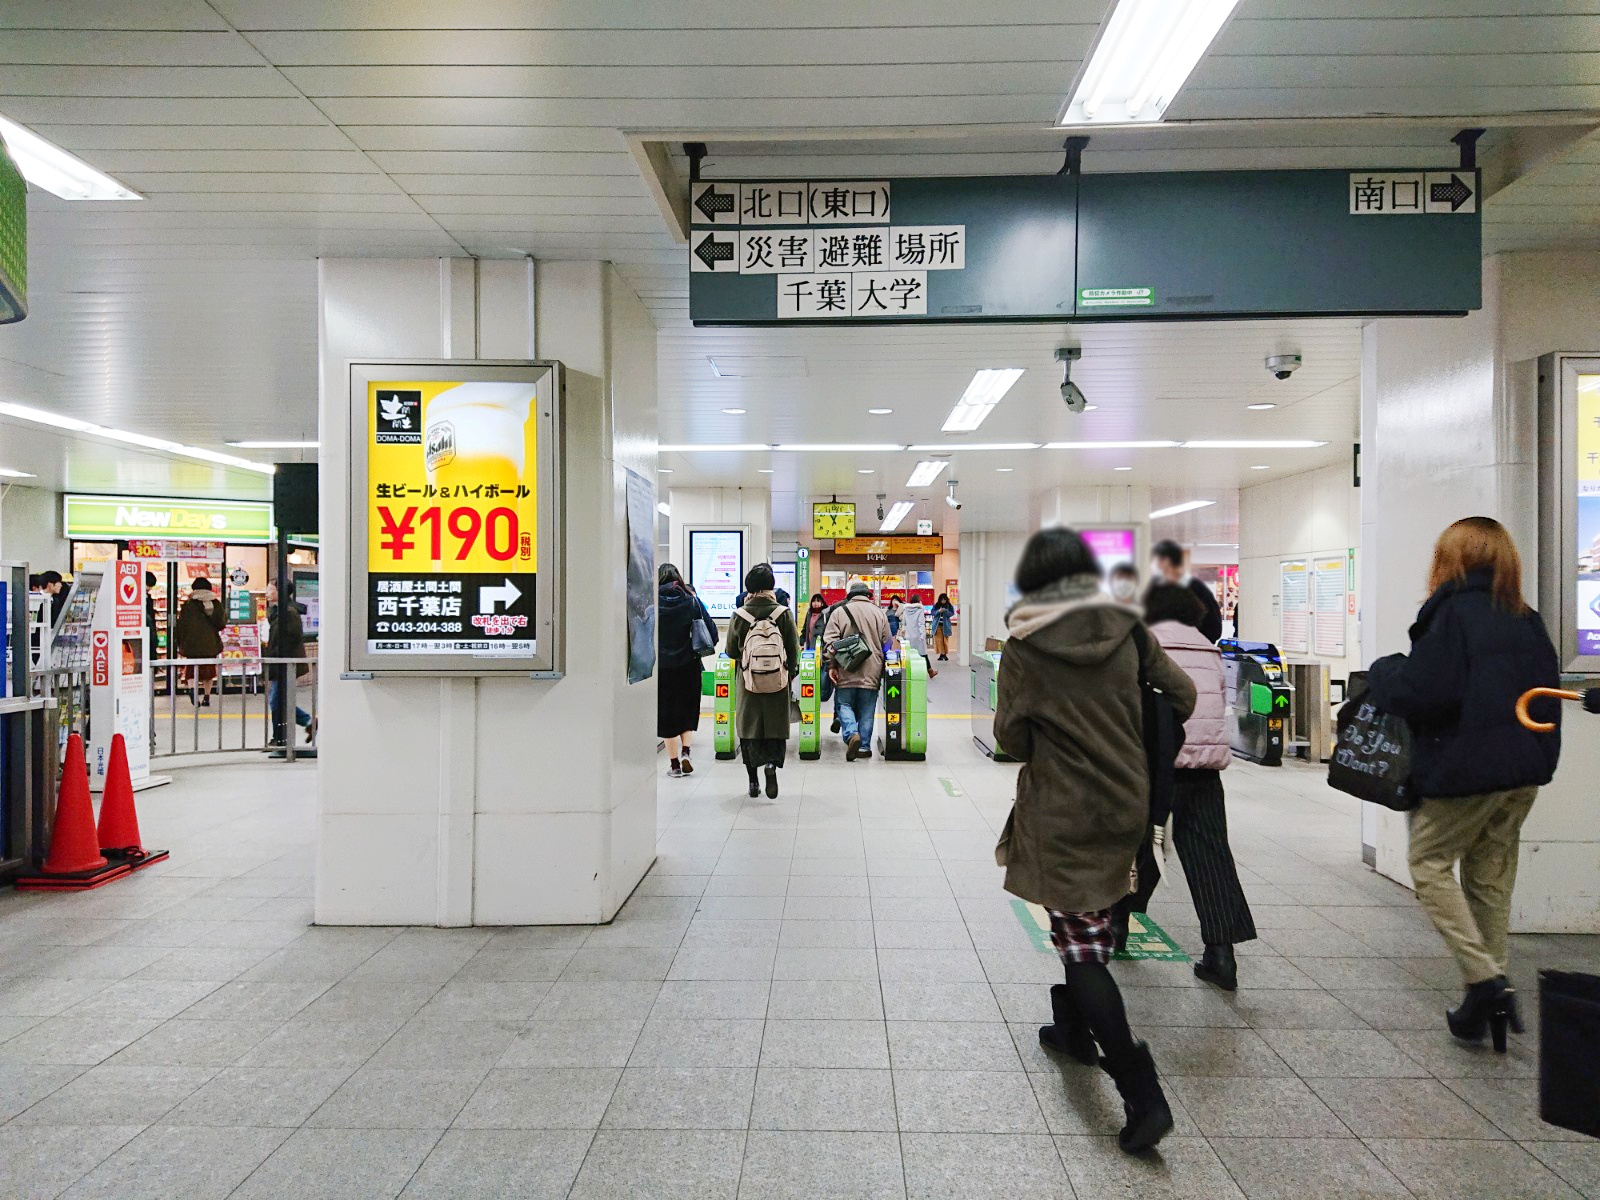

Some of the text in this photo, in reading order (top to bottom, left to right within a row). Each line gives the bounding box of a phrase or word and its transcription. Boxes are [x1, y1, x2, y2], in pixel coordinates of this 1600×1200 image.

[1353, 177, 1419, 211] 南口
[783, 278, 921, 312] 千葉大学
[114, 506, 227, 529] NewDays
[376, 506, 519, 561] ¥190
[120, 563, 138, 575] AED
[377, 596, 462, 617] 西千葉店
[472, 616, 527, 626] 改札を出て右
[391, 622, 462, 633] 043-204-388
[95, 649, 106, 684] AED
[716, 662, 730, 670] IC
[801, 662, 815, 670] IC
[717, 685, 728, 697] IC
[802, 685, 813, 697] IC
